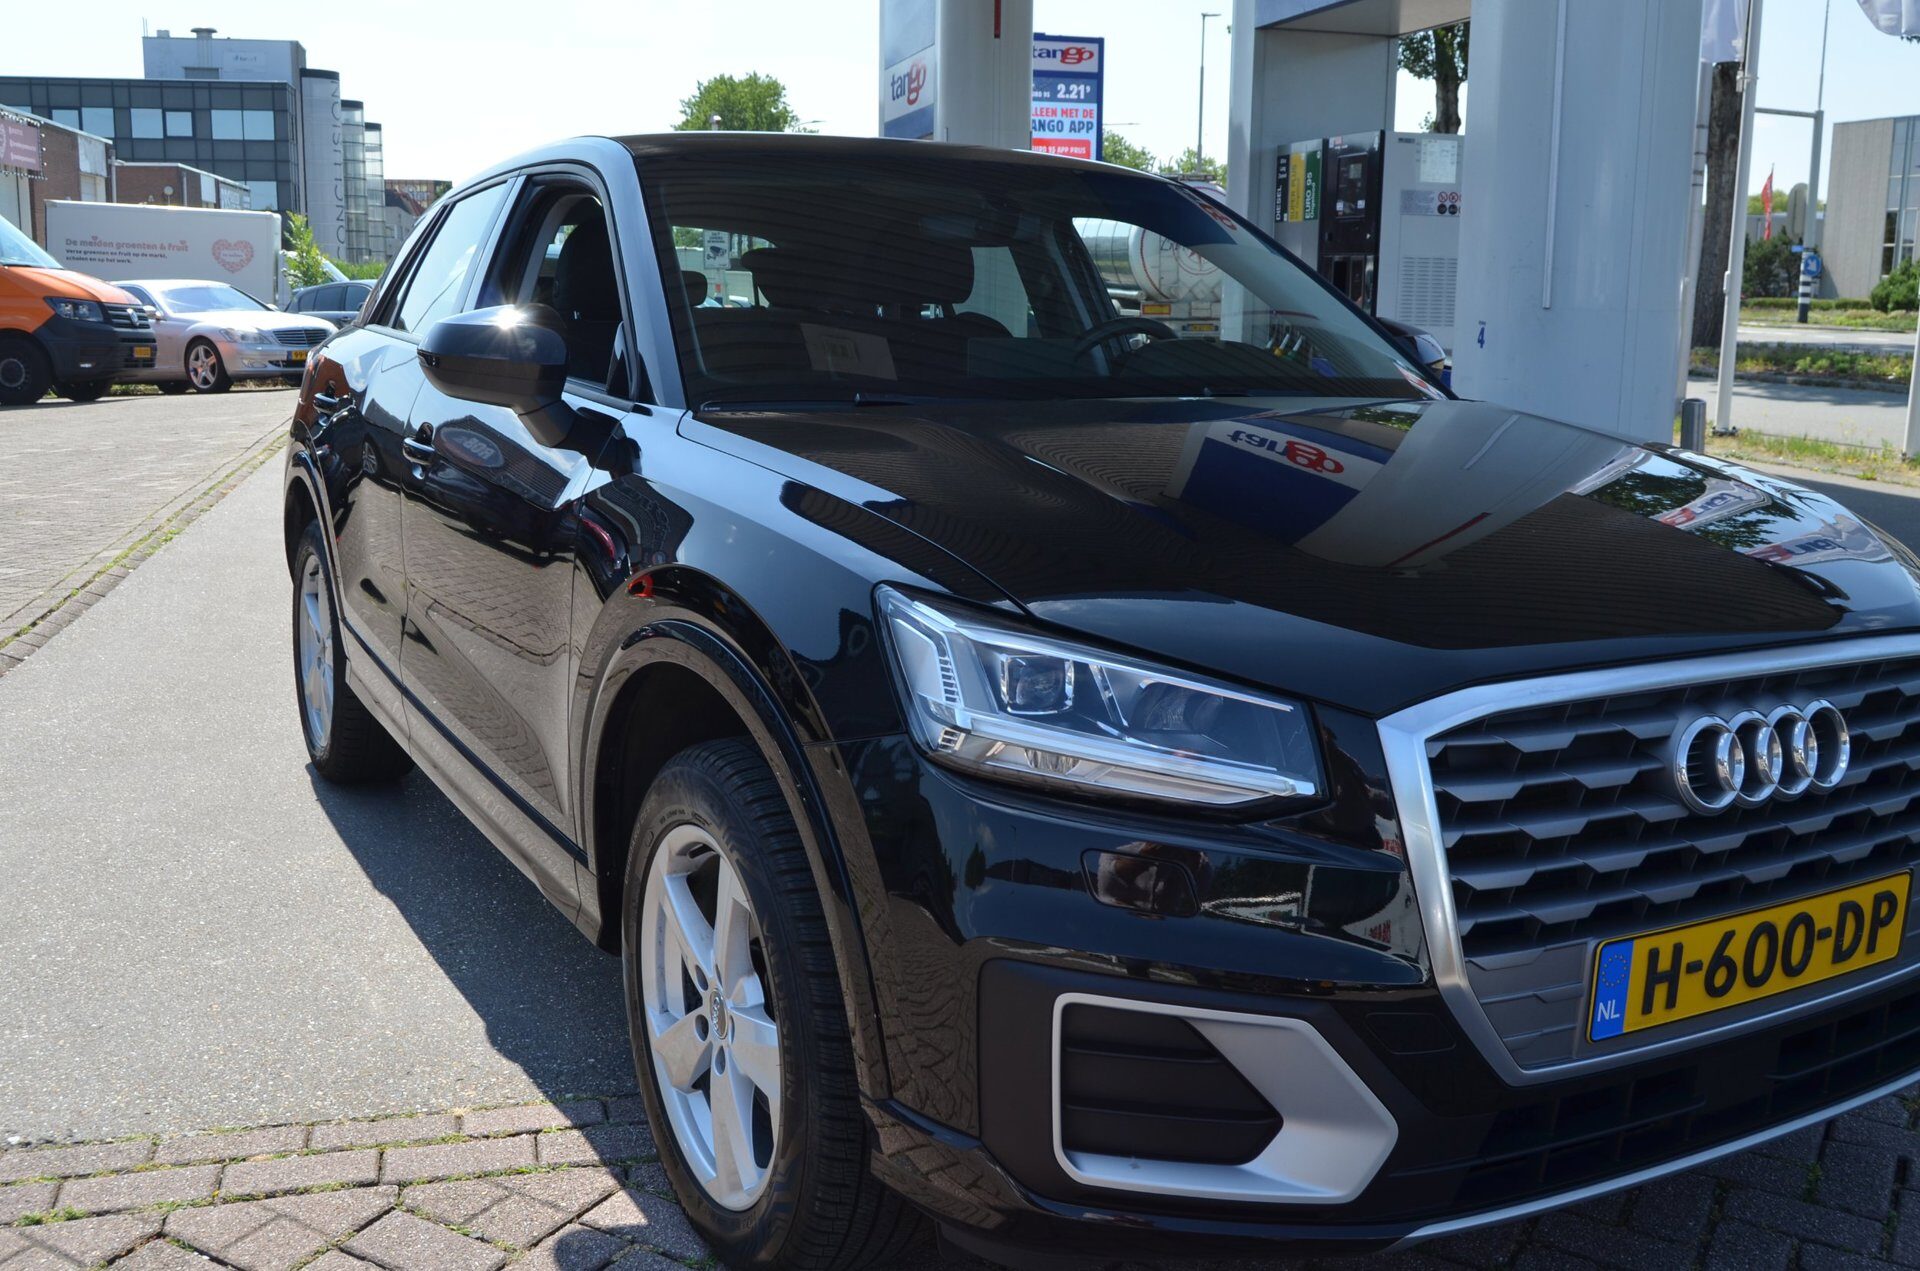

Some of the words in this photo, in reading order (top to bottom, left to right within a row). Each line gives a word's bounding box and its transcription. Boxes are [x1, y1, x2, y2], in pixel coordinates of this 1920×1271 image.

[1032, 45, 1095, 65] tango
[891, 62, 927, 105] tango
[1061, 107, 1080, 118] MET
[1082, 109, 1095, 119] DE
[1069, 120, 1094, 134] APP
[1306, 171, 1313, 186] 95
[1275, 184, 1283, 221] DIESEL
[65, 238, 78, 246] De
[80, 239, 113, 249] meiden
[115, 240, 158, 251] groenten
[159, 242, 167, 250] &
[167, 242, 189, 252] fruit
[1477, 326, 1486, 350] 4
[1641, 889, 1898, 1016] H-600-DP
[1597, 999, 1621, 1022] NL
